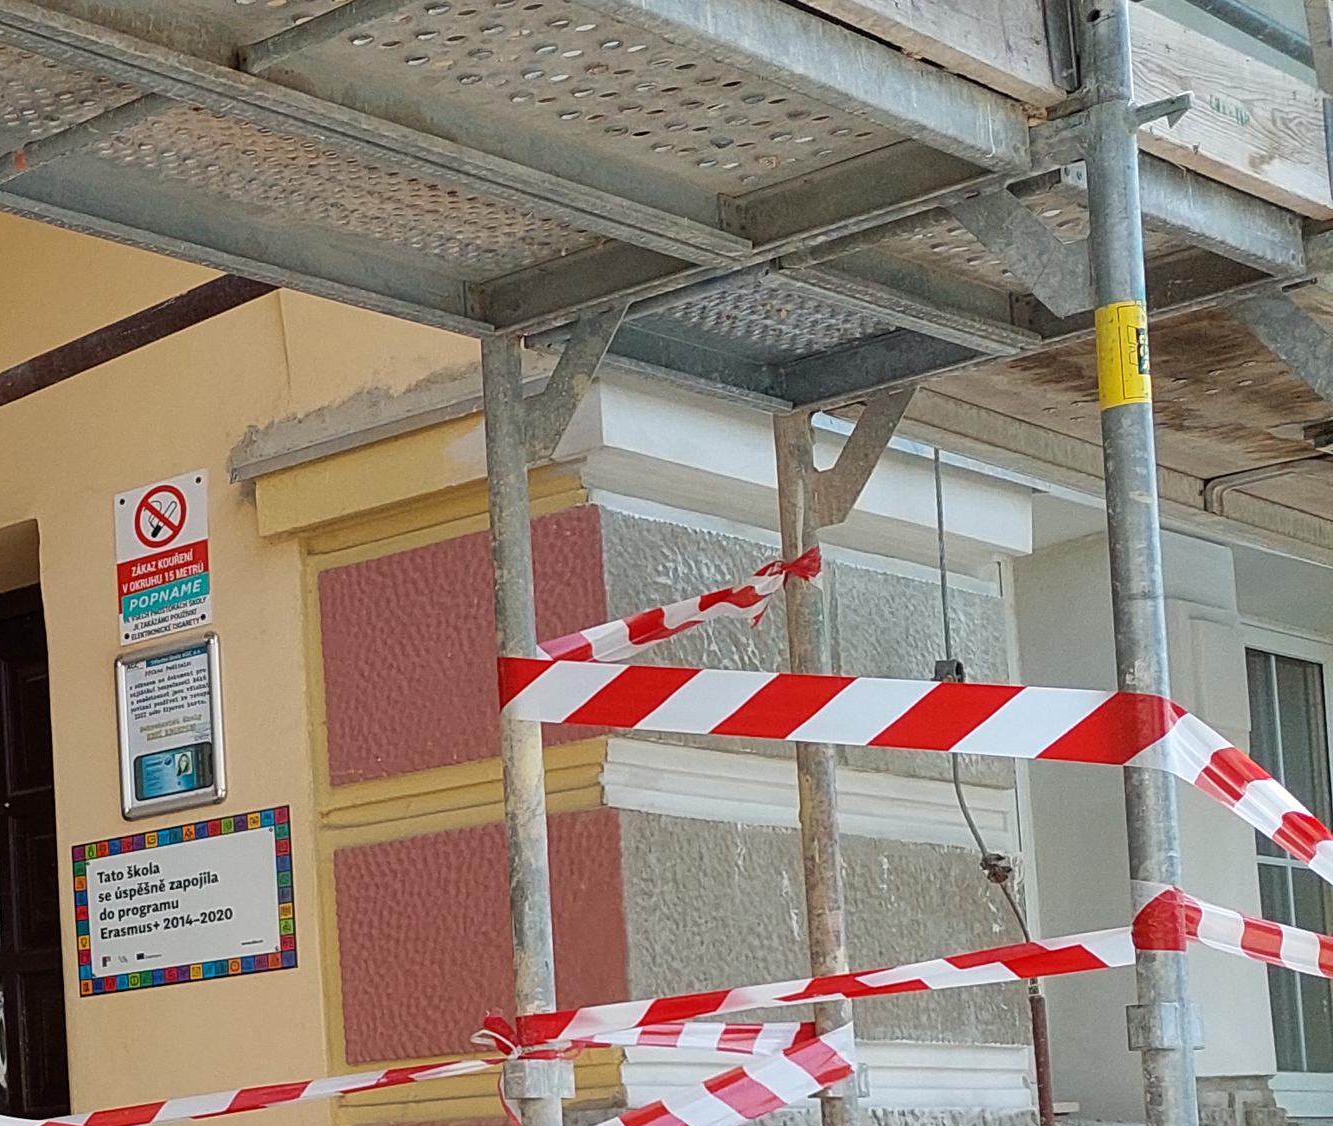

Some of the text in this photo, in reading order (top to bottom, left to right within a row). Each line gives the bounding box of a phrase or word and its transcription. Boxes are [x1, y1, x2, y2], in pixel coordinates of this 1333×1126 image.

[131, 549, 193, 577] ZÁKAZ KOUŘENÍ
[123, 562, 204, 593] V OKRUHU 15 METRŮ
[129, 580, 201, 611] POPNAME
[97, 862, 160, 884] Tato škola
[98, 871, 219, 903] se úspěšně zapojila
[99, 900, 179, 921] do programu
[100, 921, 160, 940] Erasmus+
